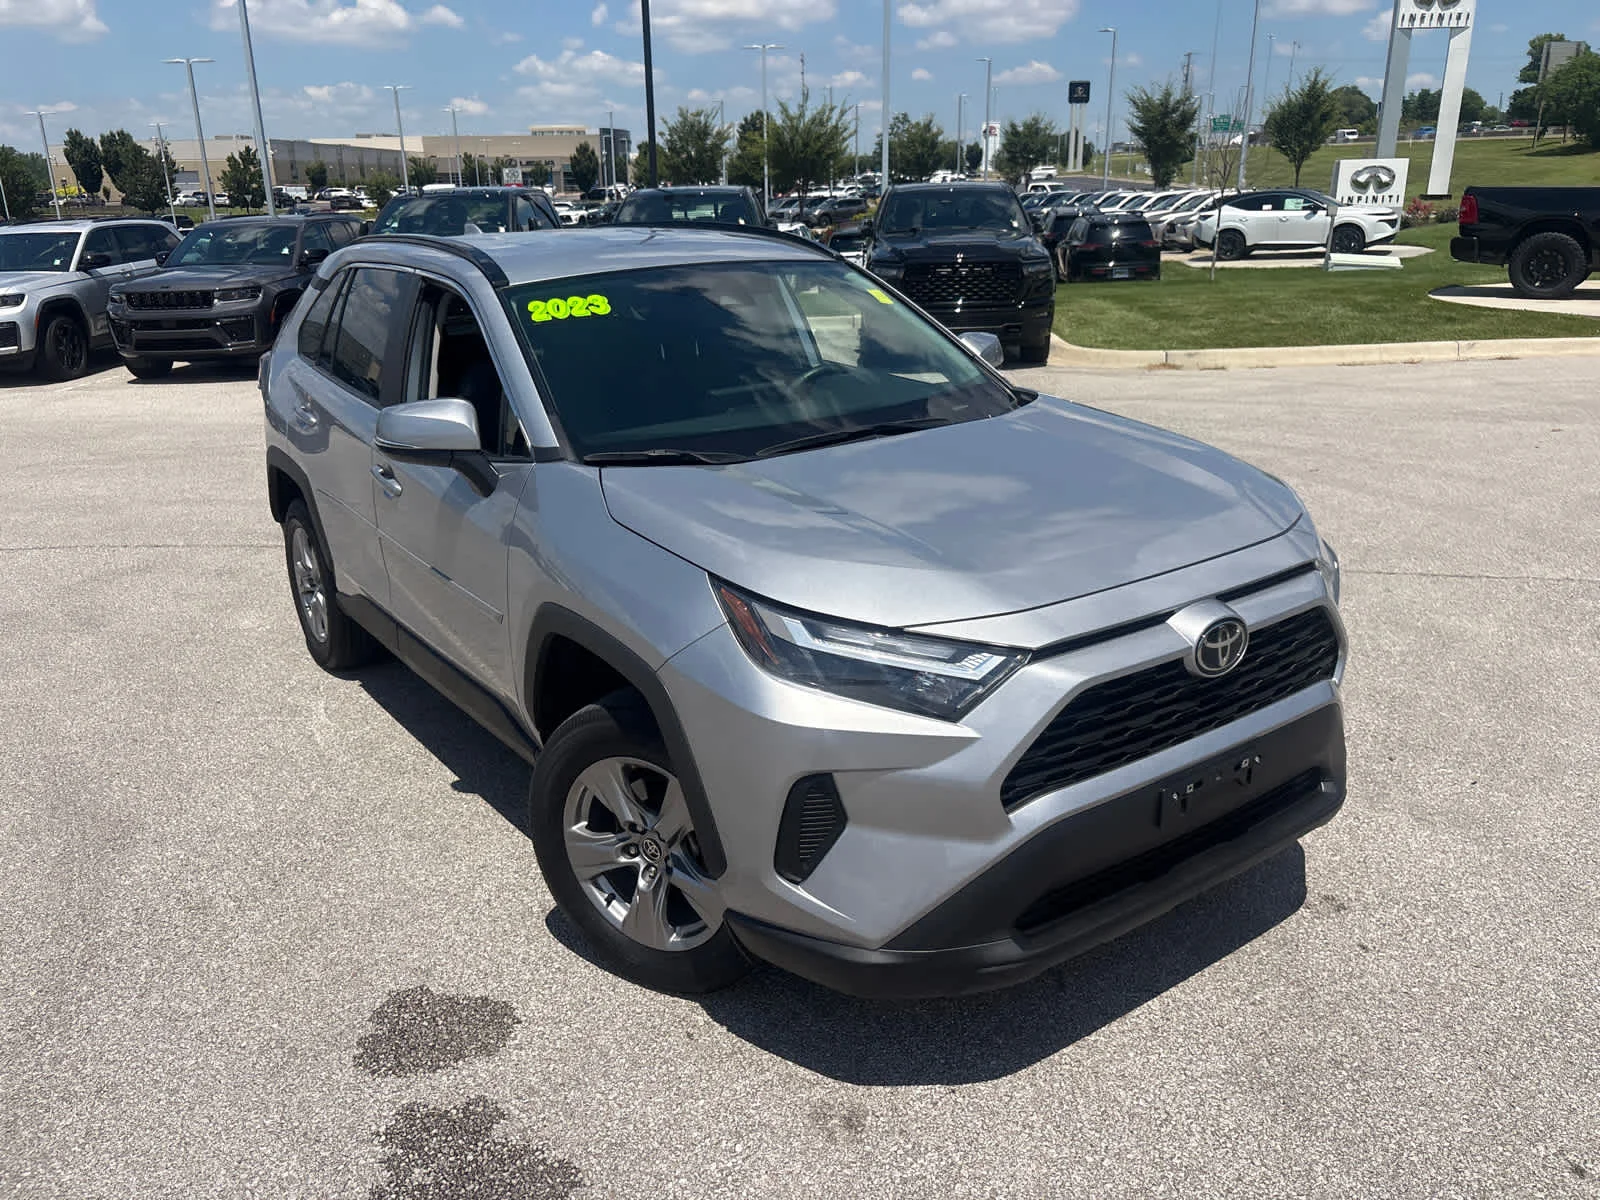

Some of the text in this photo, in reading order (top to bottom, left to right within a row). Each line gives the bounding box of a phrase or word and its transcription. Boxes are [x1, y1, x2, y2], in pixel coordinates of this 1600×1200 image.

[1400, 12, 1471, 27] INFINITI
[1341, 194, 1400, 204] INFINITI
[527, 294, 611, 322] 2023
